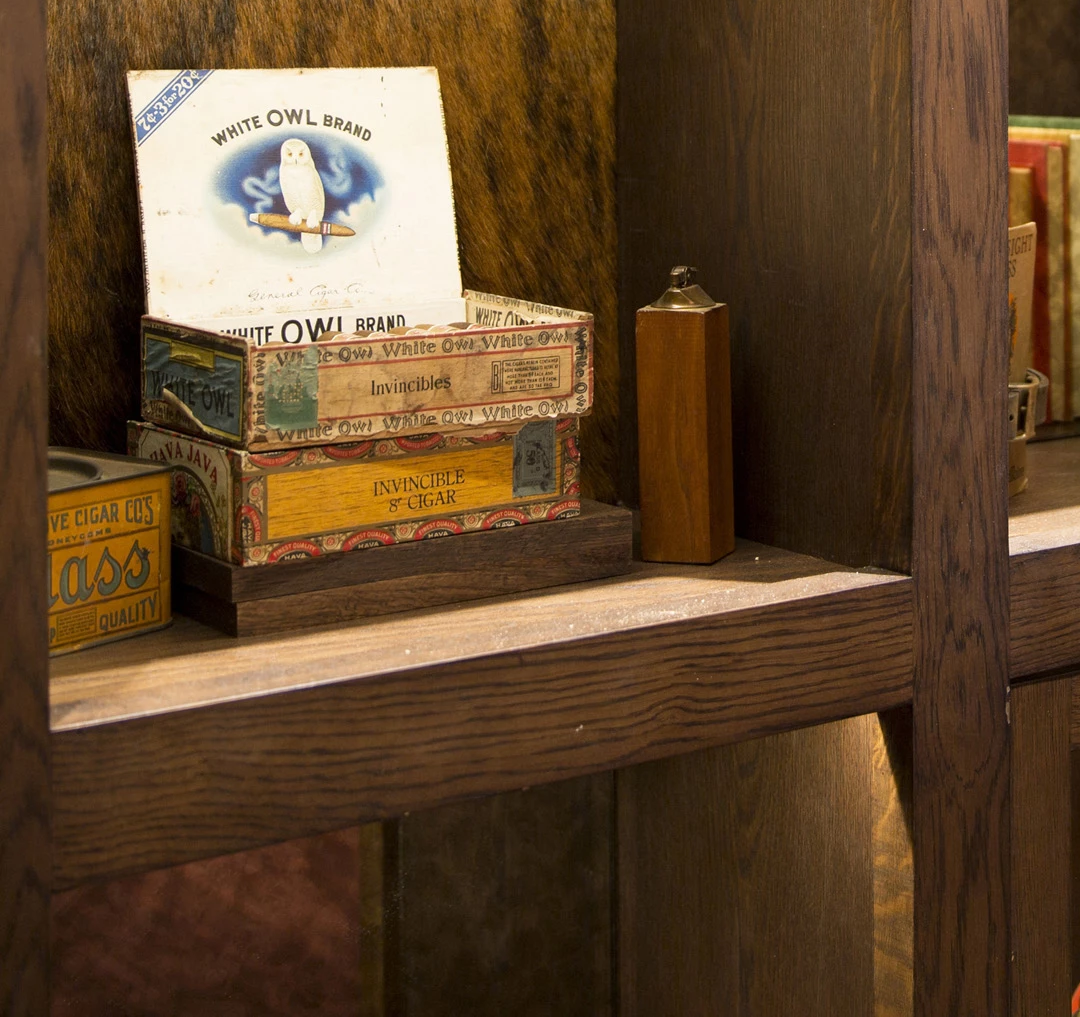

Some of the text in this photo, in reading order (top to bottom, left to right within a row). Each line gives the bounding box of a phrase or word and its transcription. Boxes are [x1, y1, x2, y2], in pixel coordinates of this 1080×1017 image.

[211, 109, 372, 147] WHITE OWL BRAND
[356, 314, 406, 333] BRAND
[475, 307, 503, 327] WHITE
[338, 345, 373, 364] Owl
[382, 338, 436, 358] White
[442, 337, 474, 355] Owl
[481, 331, 533, 350] White
[538, 330, 569, 347] Owl
[371, 374, 452, 396] Invincibles
[201, 384, 235, 418] OWL
[338, 418, 373, 436] Owl
[383, 412, 437, 432] White
[442, 410, 474, 425] Owl
[481, 403, 533, 421] White
[538, 400, 569, 416] Owl
[187, 443, 218, 485] JAVA
[373, 468, 465, 497] INVINCIBLE
[407, 489, 457, 510] CIGAR
[48, 495, 154, 534] VE CIGAR CO'S
[292, 541, 316, 552] QUALITY
[358, 540, 380, 549] HAVA
[428, 530, 449, 538] HAVA
[284, 552, 307, 561] HAVA
[100, 591, 158, 631] QUALITY
